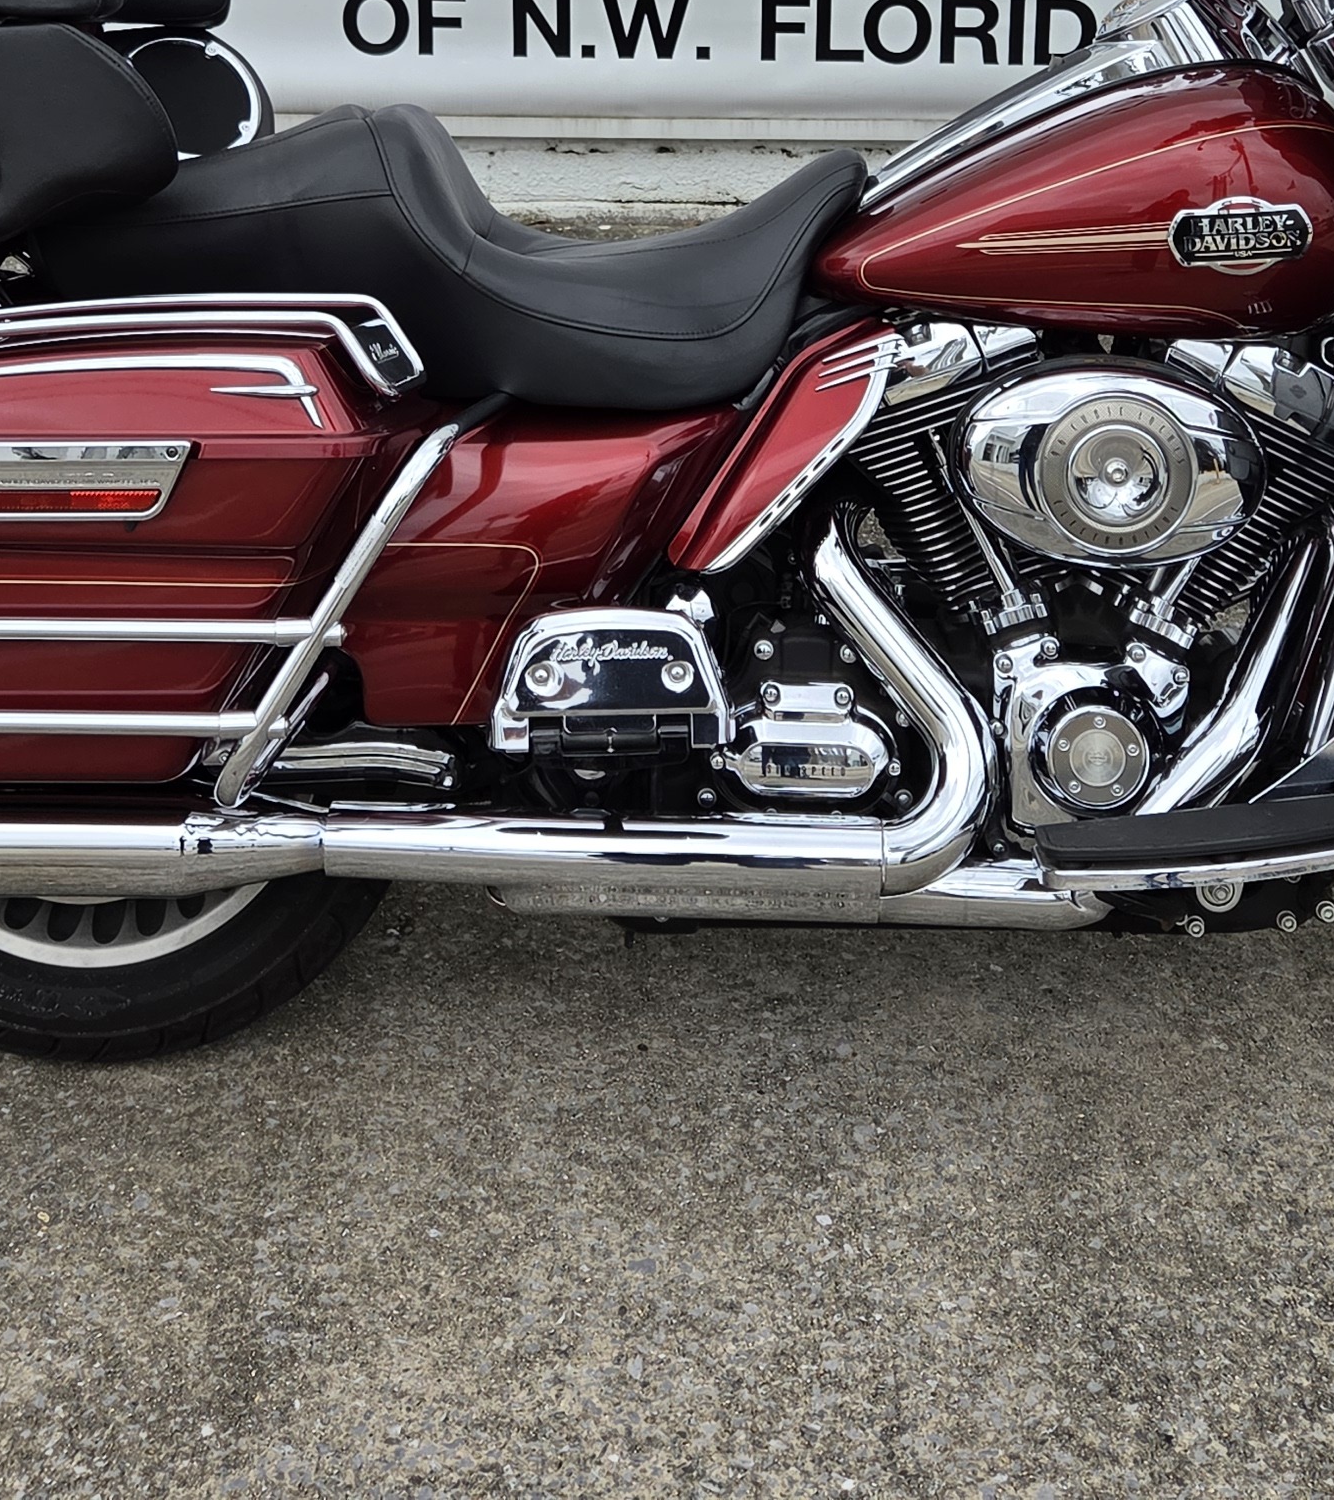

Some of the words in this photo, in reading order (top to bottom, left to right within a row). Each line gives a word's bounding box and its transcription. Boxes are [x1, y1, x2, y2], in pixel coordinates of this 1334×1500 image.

[1190, 214, 1295, 236] HARLEY-
[1183, 230, 1302, 253] DAVIDSON
[1234, 250, 1253, 258] USA
[799, 764, 847, 777] SPEED
